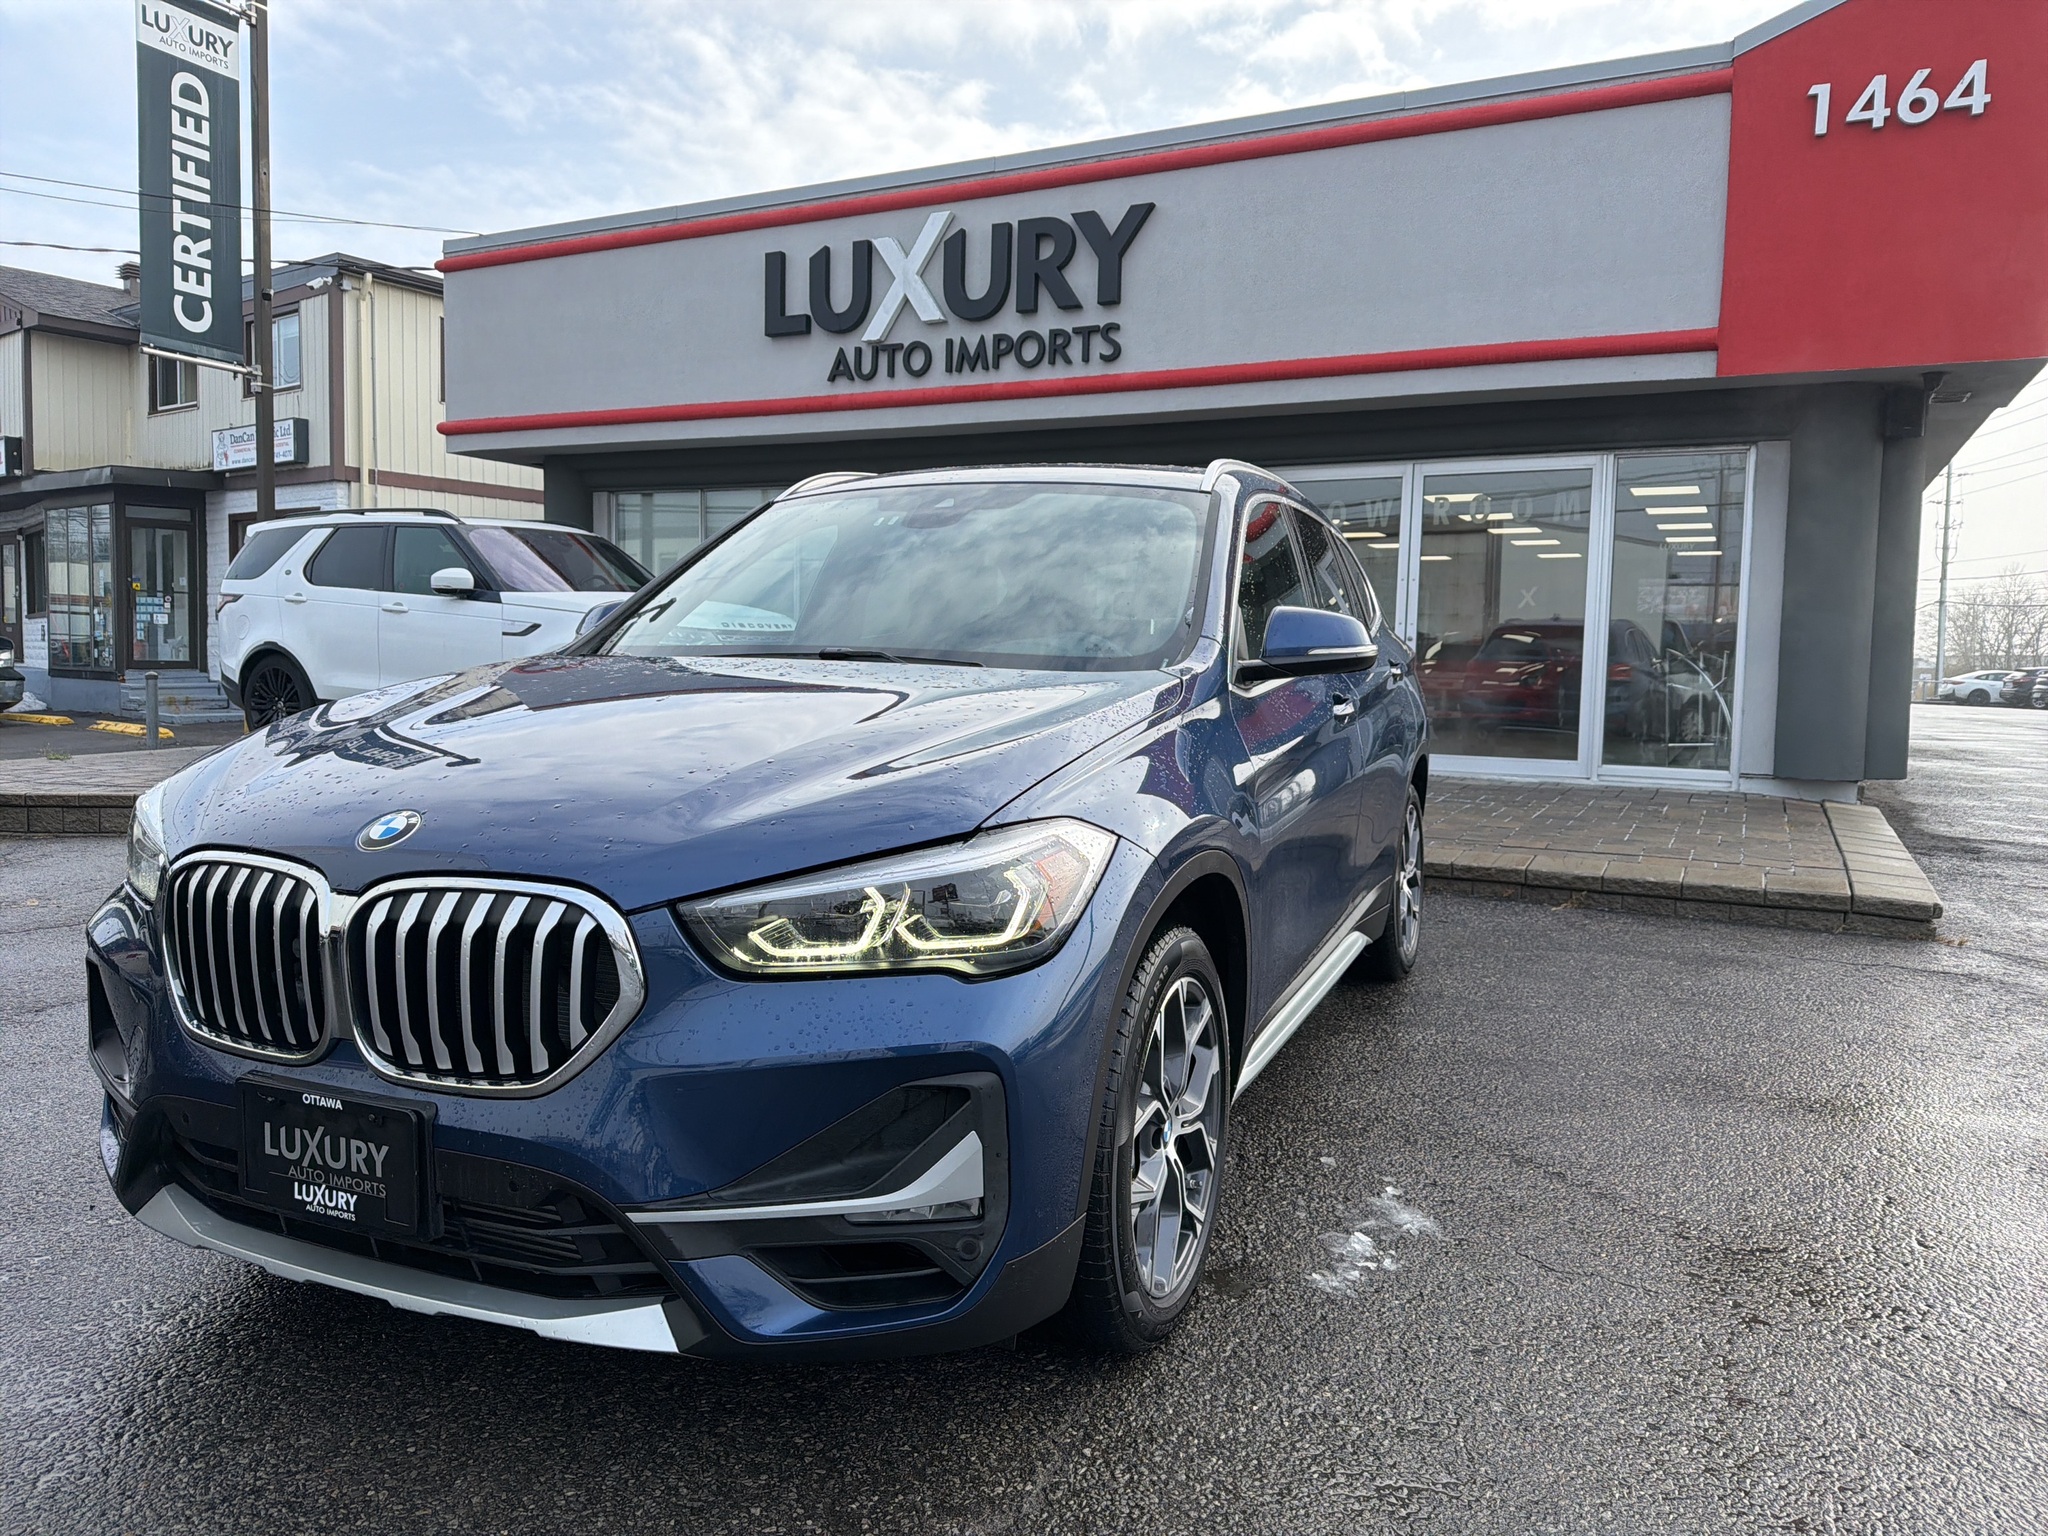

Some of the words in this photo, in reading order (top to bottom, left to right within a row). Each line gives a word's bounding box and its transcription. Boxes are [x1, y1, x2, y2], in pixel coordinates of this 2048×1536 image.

[141, 4, 234, 58] LUXURY
[159, 35, 186, 52] AUTO
[189, 47, 229, 69] IMPORTS
[1807, 58, 1991, 137] 1464
[171, 71, 213, 334] CERTIFIED
[764, 202, 1156, 344] LUXURY
[827, 340, 933, 382] AUTO
[944, 322, 1122, 374] IMPORTS
[230, 432, 255, 444] DanCan
[1432, 490, 1581, 526] ROOM
[302, 1093, 343, 1111] OTTAWA
[264, 1121, 390, 1178] LUXURY
[288, 1164, 325, 1184] AUTO
[329, 1172, 387, 1196] IMPORTS
[294, 1181, 358, 1212] LUXURY
[305, 1204, 325, 1214] AUTO
[326, 1207, 356, 1221] IMPORTS
